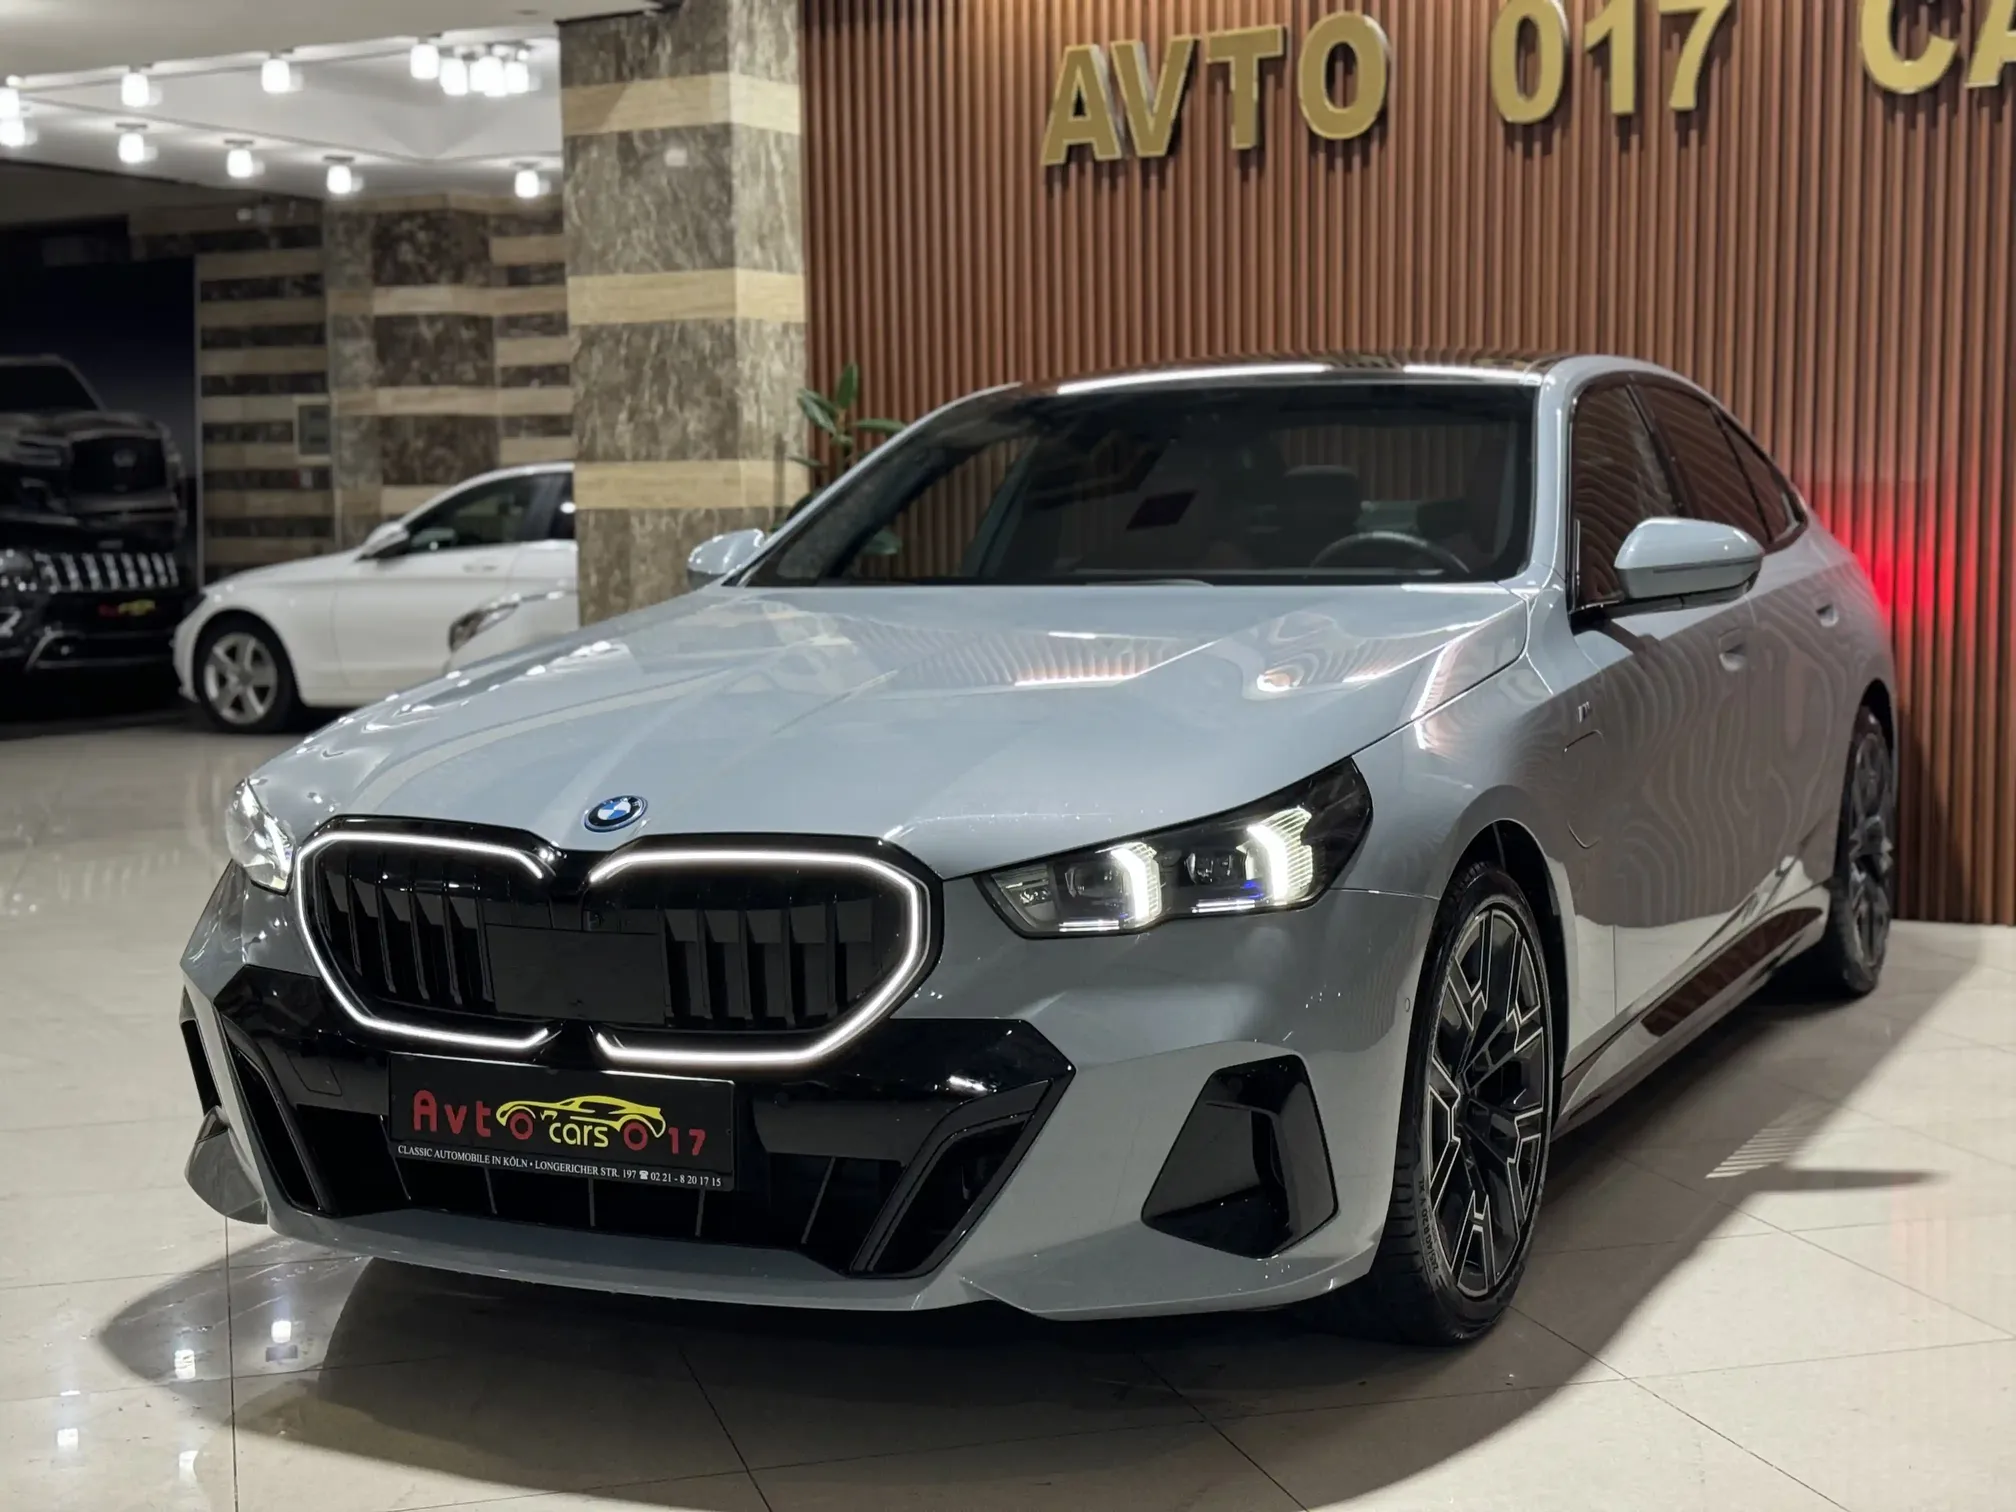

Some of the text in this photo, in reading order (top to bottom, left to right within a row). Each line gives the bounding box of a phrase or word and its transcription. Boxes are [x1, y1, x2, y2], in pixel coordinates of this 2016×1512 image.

[1040, 10, 1390, 166] AVTO
[1490, 0, 1731, 124] 017
[413, 1089, 534, 1140] Avto
[549, 1122, 609, 1148] cars
[398, 1145, 433, 1157] CLASSIC
[434, 1149, 490, 1163] AUTOMOBILE
[491, 1155, 501, 1165] IN
[503, 1155, 528, 1168] KÖLN
[535, 1160, 599, 1175] LONGERICHER
[600, 1167, 620, 1177] STR.
[623, 1168, 637, 1179] 197
[650, 1172, 661, 1181] 02
[662, 1173, 672, 1182] 21
[687, 1175, 697, 1185] 20
[700, 1176, 709, 1186] 17
[712, 1177, 721, 1187] 15
